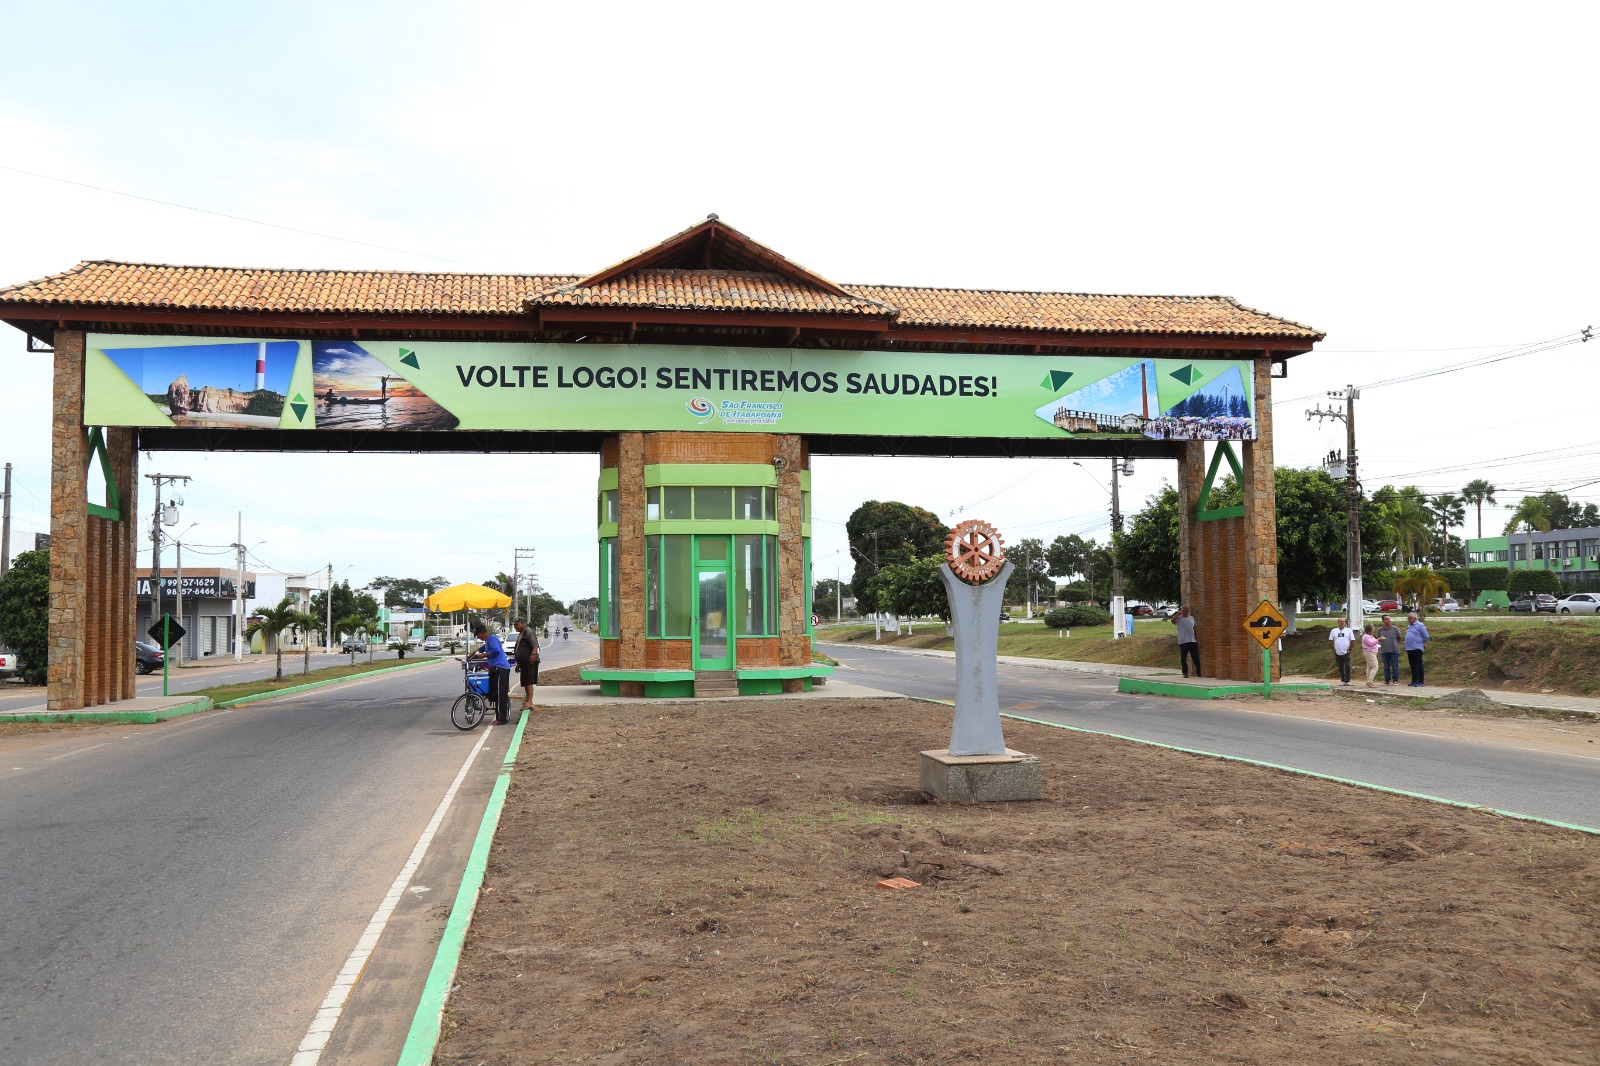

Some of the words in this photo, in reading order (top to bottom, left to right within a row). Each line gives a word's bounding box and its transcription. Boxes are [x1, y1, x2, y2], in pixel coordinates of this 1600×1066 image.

[456, 365, 549, 388] VOLTE
[557, 366, 647, 389] LOGO!
[655, 367, 839, 394] SENTIREMOS
[845, 372, 998, 398] SAUDADES!
[740, 400, 783, 410] FRANCISCO
[732, 410, 782, 418] ITABAPOANA
[167, 578, 215, 587] 9937-1629
[166, 587, 215, 596] 9857-8466
